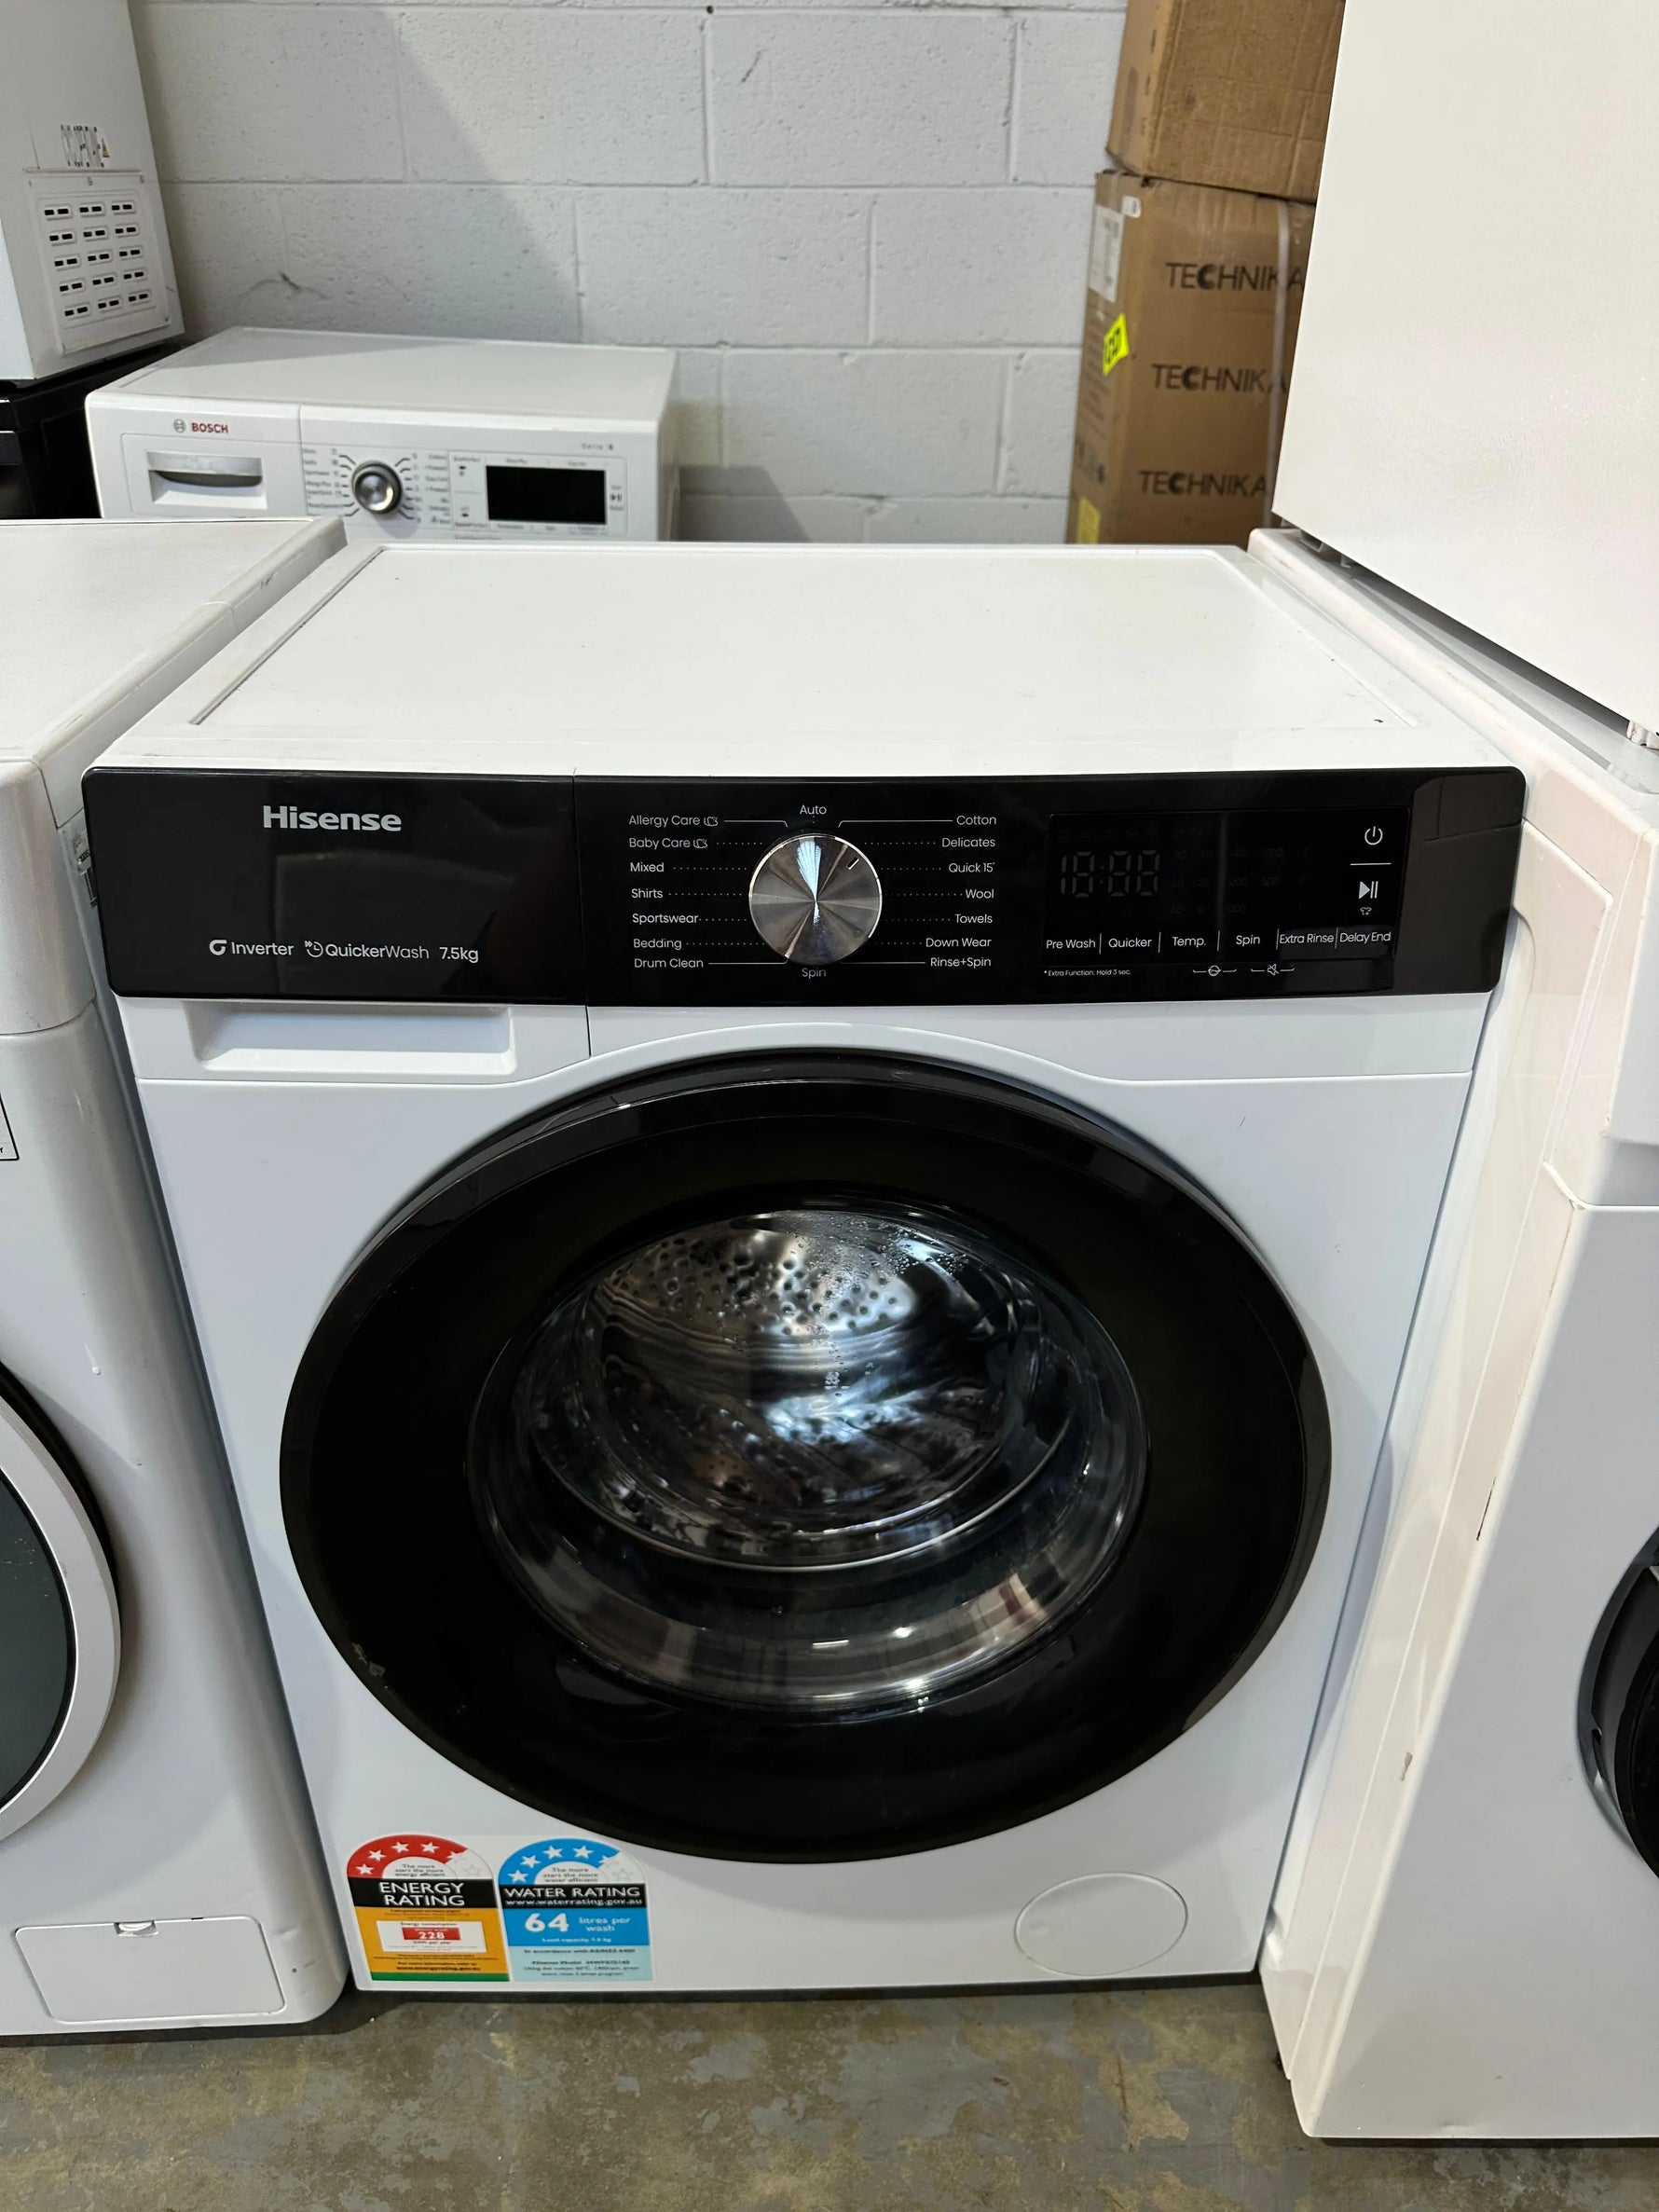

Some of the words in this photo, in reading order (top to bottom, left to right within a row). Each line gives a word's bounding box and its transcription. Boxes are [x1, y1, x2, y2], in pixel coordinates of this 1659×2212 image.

[191, 422, 229, 433] BOSCH
[799, 804, 828, 816] Auto
[262, 804, 402, 831] Hisense
[628, 815, 668, 827] Allergy
[671, 816, 701, 826] Care
[956, 815, 997, 826] Cotton
[628, 837, 660, 850] Baby
[661, 838, 691, 848] Care
[941, 837, 996, 848] Delicates
[629, 861, 665, 872] Mixed
[948, 862, 981, 873] Quick
[631, 888, 664, 899] Shirts
[965, 888, 994, 900] Wool
[632, 913, 699, 926] Sportswear
[954, 914, 994, 924] Towels
[925, 938, 959, 948] Down
[961, 938, 993, 948] Wear
[1108, 937, 1153, 948] Quicker
[1172, 936, 1207, 948] Temp.
[1235, 934, 1261, 947] Spin
[1279, 934, 1305, 944] Extra
[1307, 933, 1335, 943] Rinse
[1339, 932, 1370, 944] Delay
[1371, 931, 1392, 942] End
[633, 938, 682, 951] Bedding
[1046, 939, 1063, 950] Pre
[1065, 938, 1096, 949] Wash
[230, 941, 295, 956] Inverter
[324, 942, 430, 960] QuickerWash
[439, 945, 479, 964] 7.5kg
[634, 957, 667, 969] Drum
[669, 957, 704, 969] Clean
[930, 956, 992, 969] Rinse+Spin
[801, 968, 828, 980] Spin
[379, 1881, 465, 1894] ENERGY
[504, 1887, 566, 1898] WATER
[571, 1887, 640, 1898] RATING
[384, 1894, 465, 1906] RATING
[504, 1898, 643, 1906] www.waterrating.gov.au
[524, 1912, 569, 1933] 64
[579, 1917, 609, 1925] litres
[611, 1917, 631, 1926] per
[418, 1931, 446, 1940] 228
